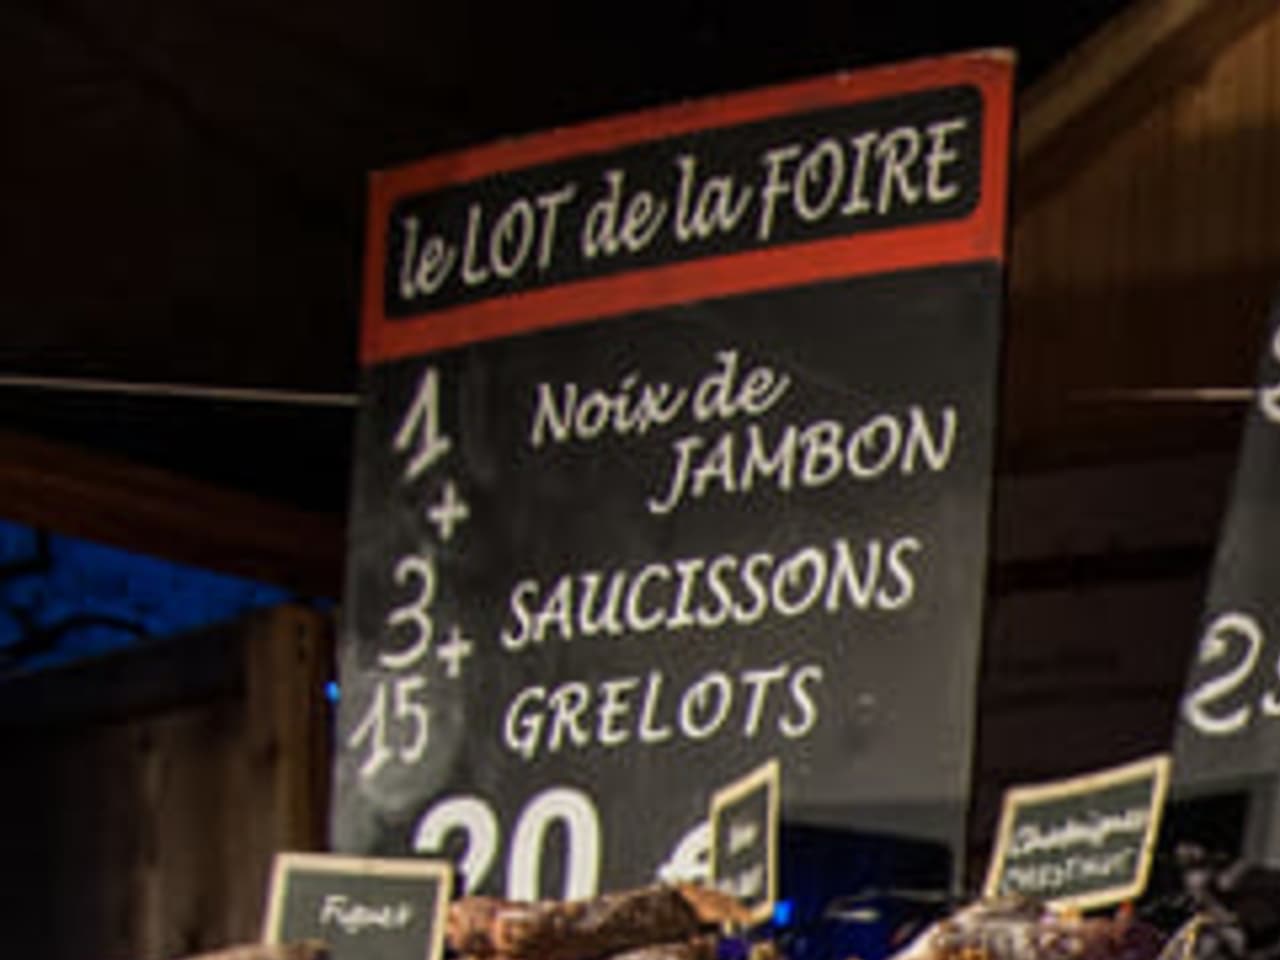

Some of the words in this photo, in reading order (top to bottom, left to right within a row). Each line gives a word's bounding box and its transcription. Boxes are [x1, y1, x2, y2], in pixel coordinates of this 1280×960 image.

[400, 215, 455, 299] le
[460, 180, 576, 285] LOT
[580, 169, 667, 260] de
[674, 156, 757, 243] la
[758, 118, 969, 242] FOIRE
[393, 366, 451, 482] 1
[530, 371, 702, 447] Noix
[692, 348, 789, 420] de
[649, 407, 957, 514] JAMBON
[427, 480, 469, 540] +
[379, 555, 436, 668] 3
[503, 536, 922, 650] SAUCISSONS
[436, 627, 473, 677] +
[348, 676, 429, 776] 15
[503, 666, 822, 758] GRELOTS
[1182, 612, 1263, 734] 2
